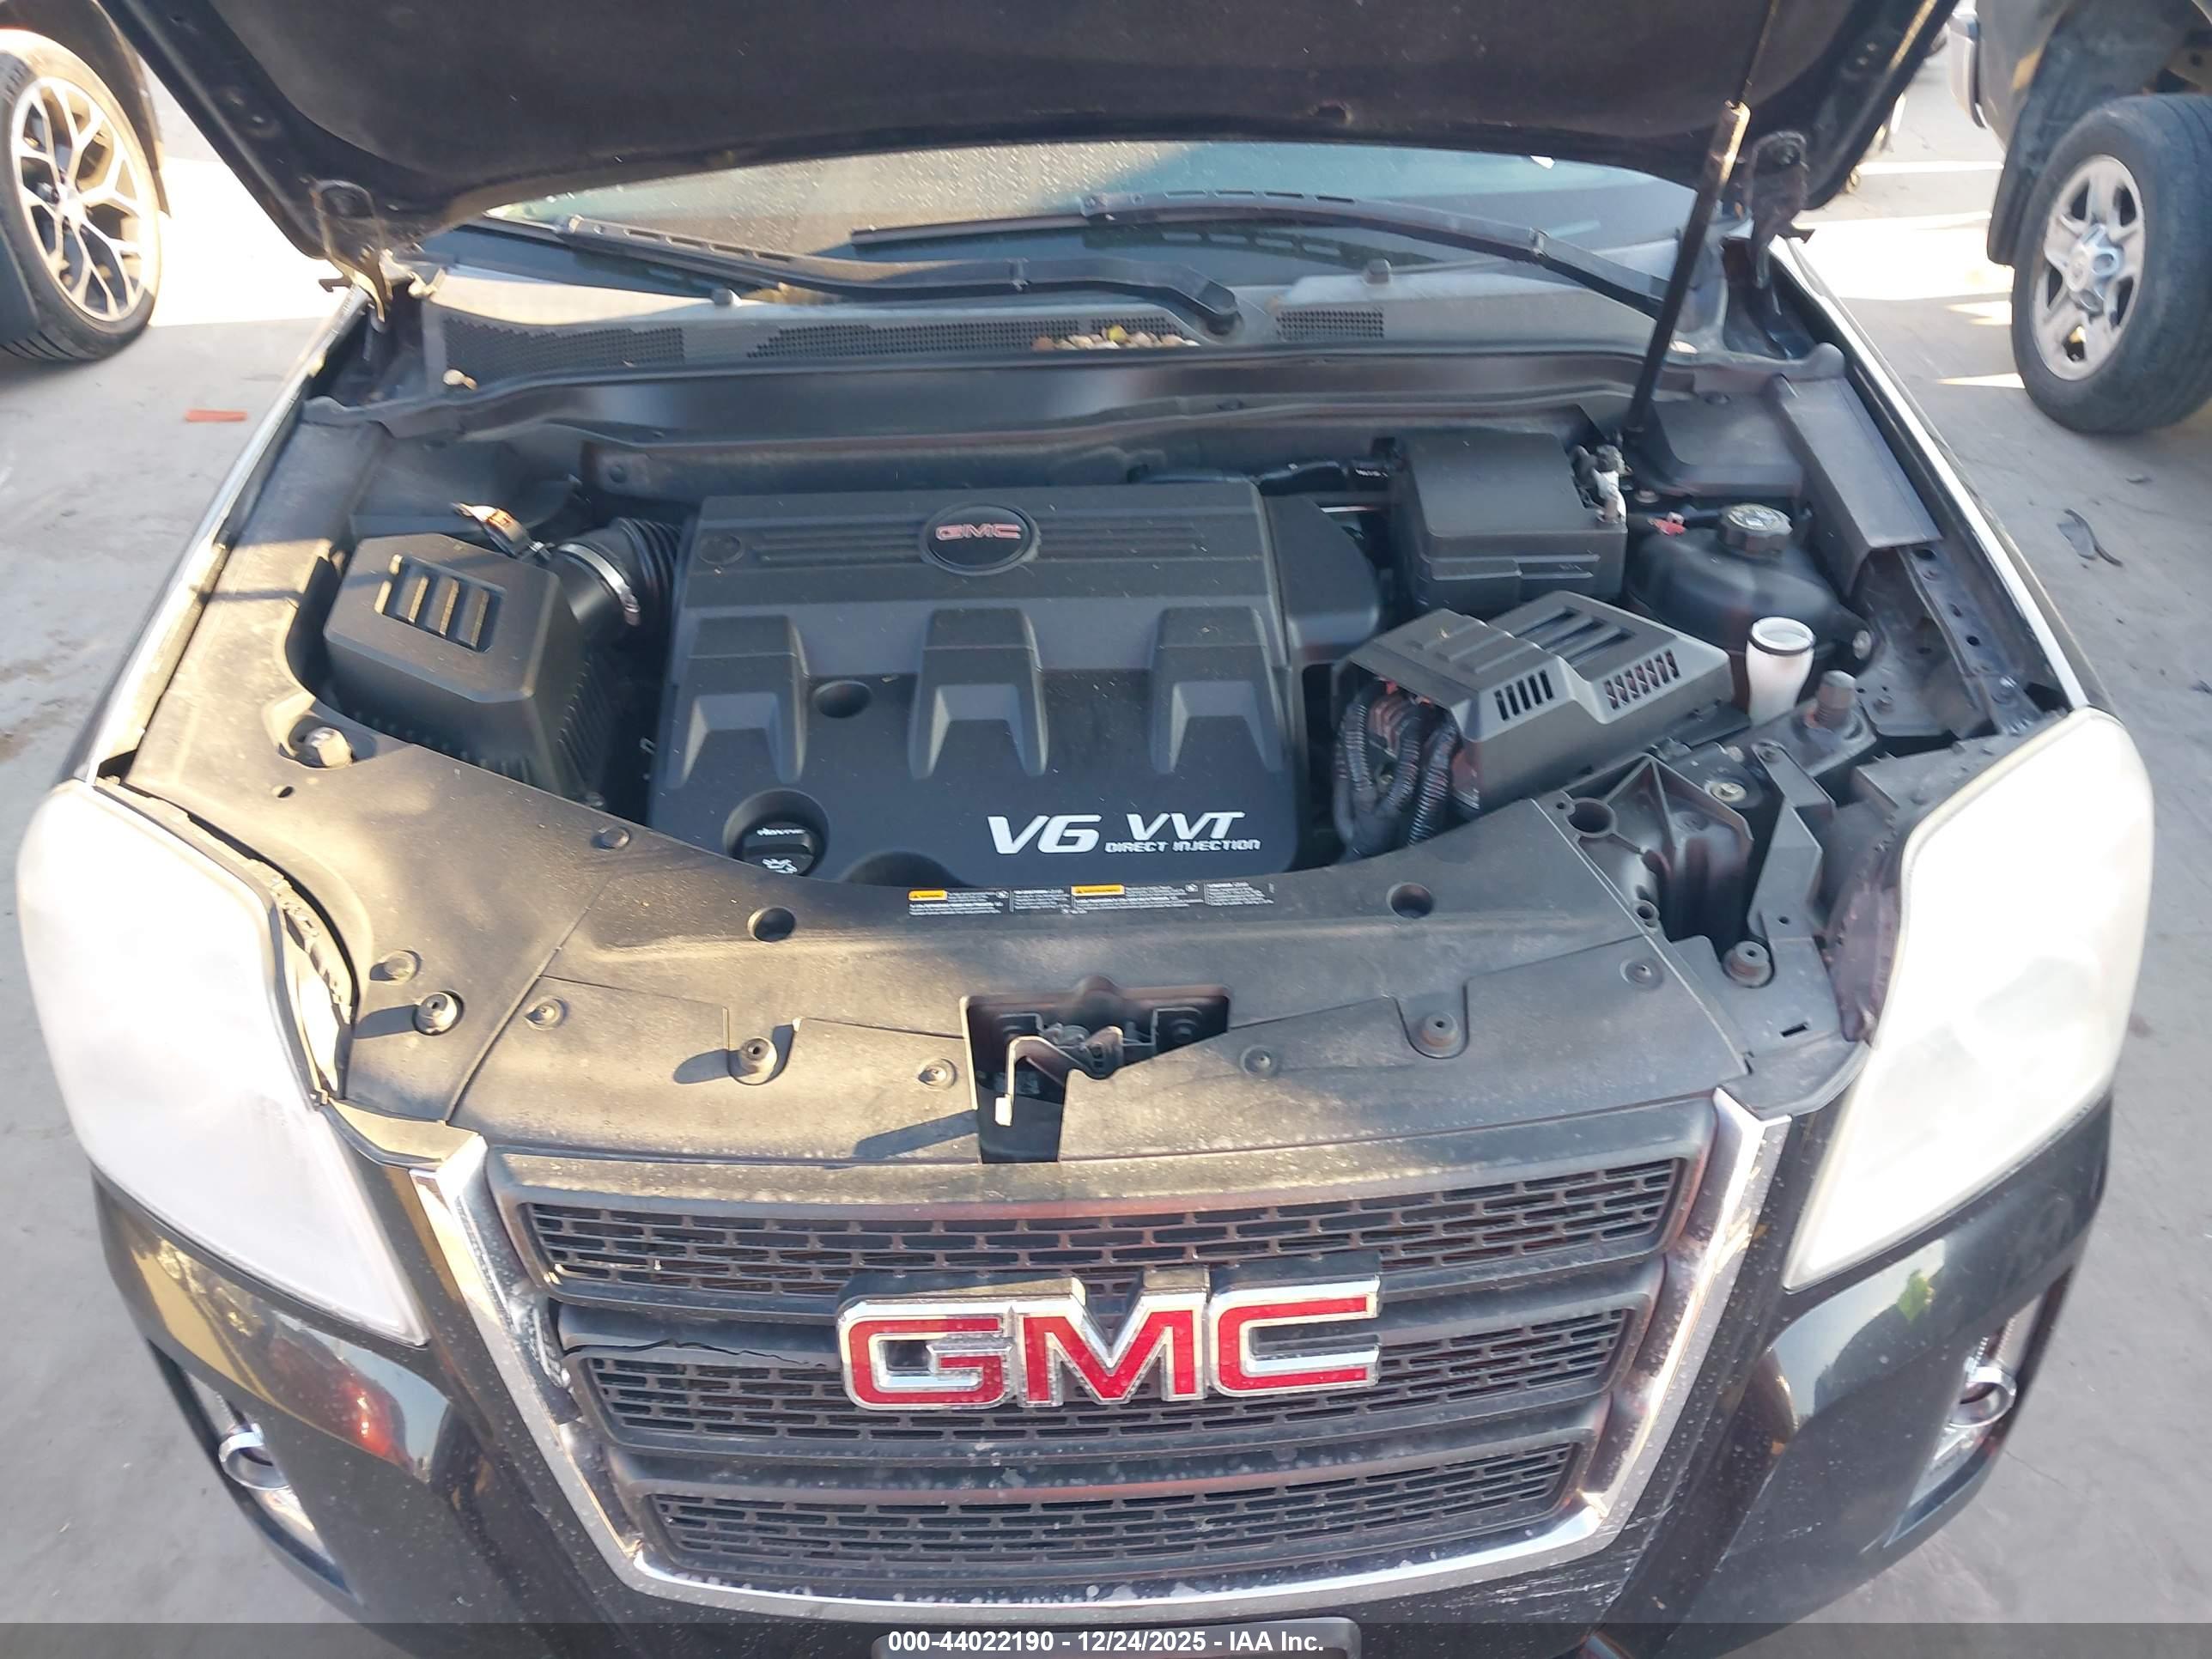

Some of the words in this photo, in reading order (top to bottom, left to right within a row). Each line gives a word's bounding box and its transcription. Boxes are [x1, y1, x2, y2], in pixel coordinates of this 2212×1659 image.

[934, 523, 1022, 541] GMC
[987, 814, 1103, 854] V6
[1126, 811, 1246, 841] VVT
[1103, 841, 1169, 854] DIRECT
[1172, 839, 1261, 853] INJECTION
[837, 1271, 1381, 1411] GMC
